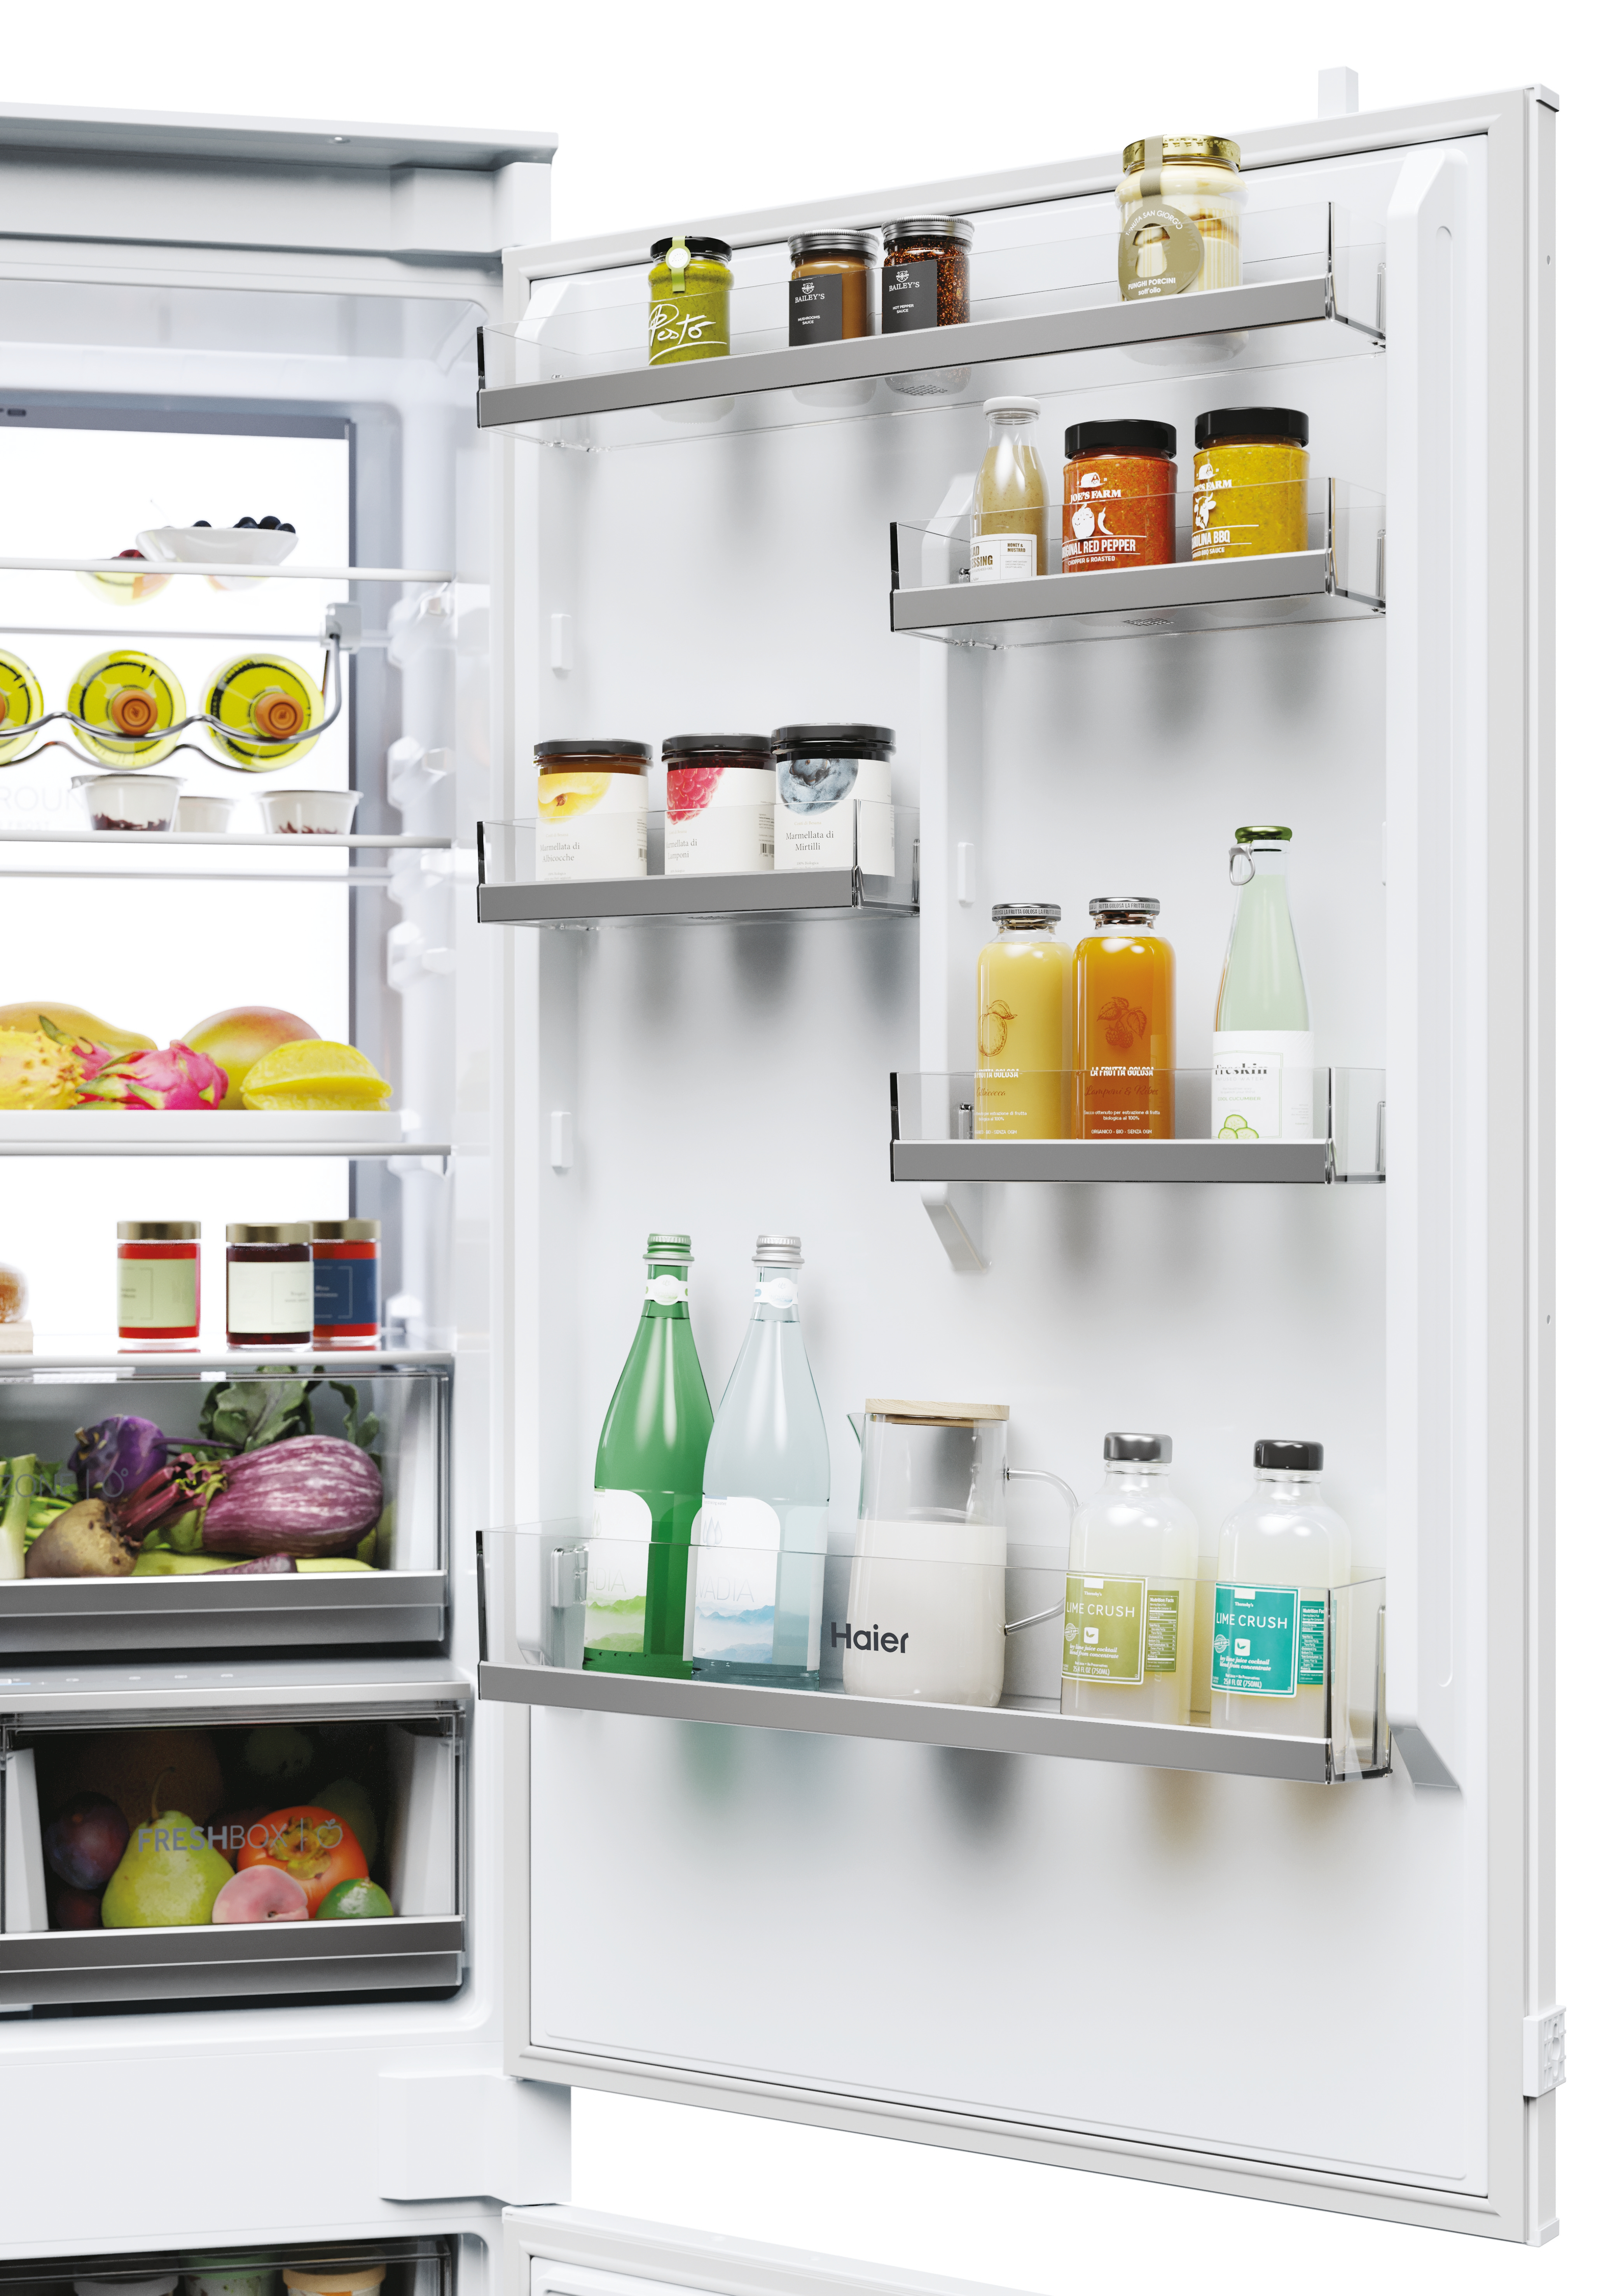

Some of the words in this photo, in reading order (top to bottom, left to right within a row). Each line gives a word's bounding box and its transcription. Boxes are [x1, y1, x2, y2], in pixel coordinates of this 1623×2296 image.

[1143, 210, 1155, 218] SAN
[889, 282, 920, 292] BAILEY'S
[1128, 280, 1148, 290] FUNGHI
[1148, 277, 1176, 286] PORCINI
[1138, 287, 1161, 295] sott'olio
[795, 294, 825, 303] BAILEY'S
[648, 303, 716, 347] Pesto
[1206, 479, 1233, 491] FARM
[1069, 491, 1090, 504] JOE'S
[1091, 489, 1122, 499] FARM
[1213, 529, 1230, 543] BBQ
[1083, 540, 1099, 554] RED
[1101, 539, 1136, 552] PEPPER
[786, 831, 824, 840] Marmellata
[540, 842, 571, 852] Marmellata
[795, 842, 821, 851] Mirtilli
[542, 853, 575, 862] Albicocche
[668, 851, 689, 861] Lamponi
[1067, 1601, 1084, 1614] LIME
[1087, 1604, 1135, 1618] CRUSH
[1216, 1613, 1235, 1625] LIME
[1238, 1615, 1288, 1629] CRUSH
[831, 1622, 909, 1654] Haier
[1092, 1667, 1110, 1676] (750ML)
[1243, 1680, 1262, 1689] (750ML)
[138, 1823, 287, 1852] FRESHBOX
